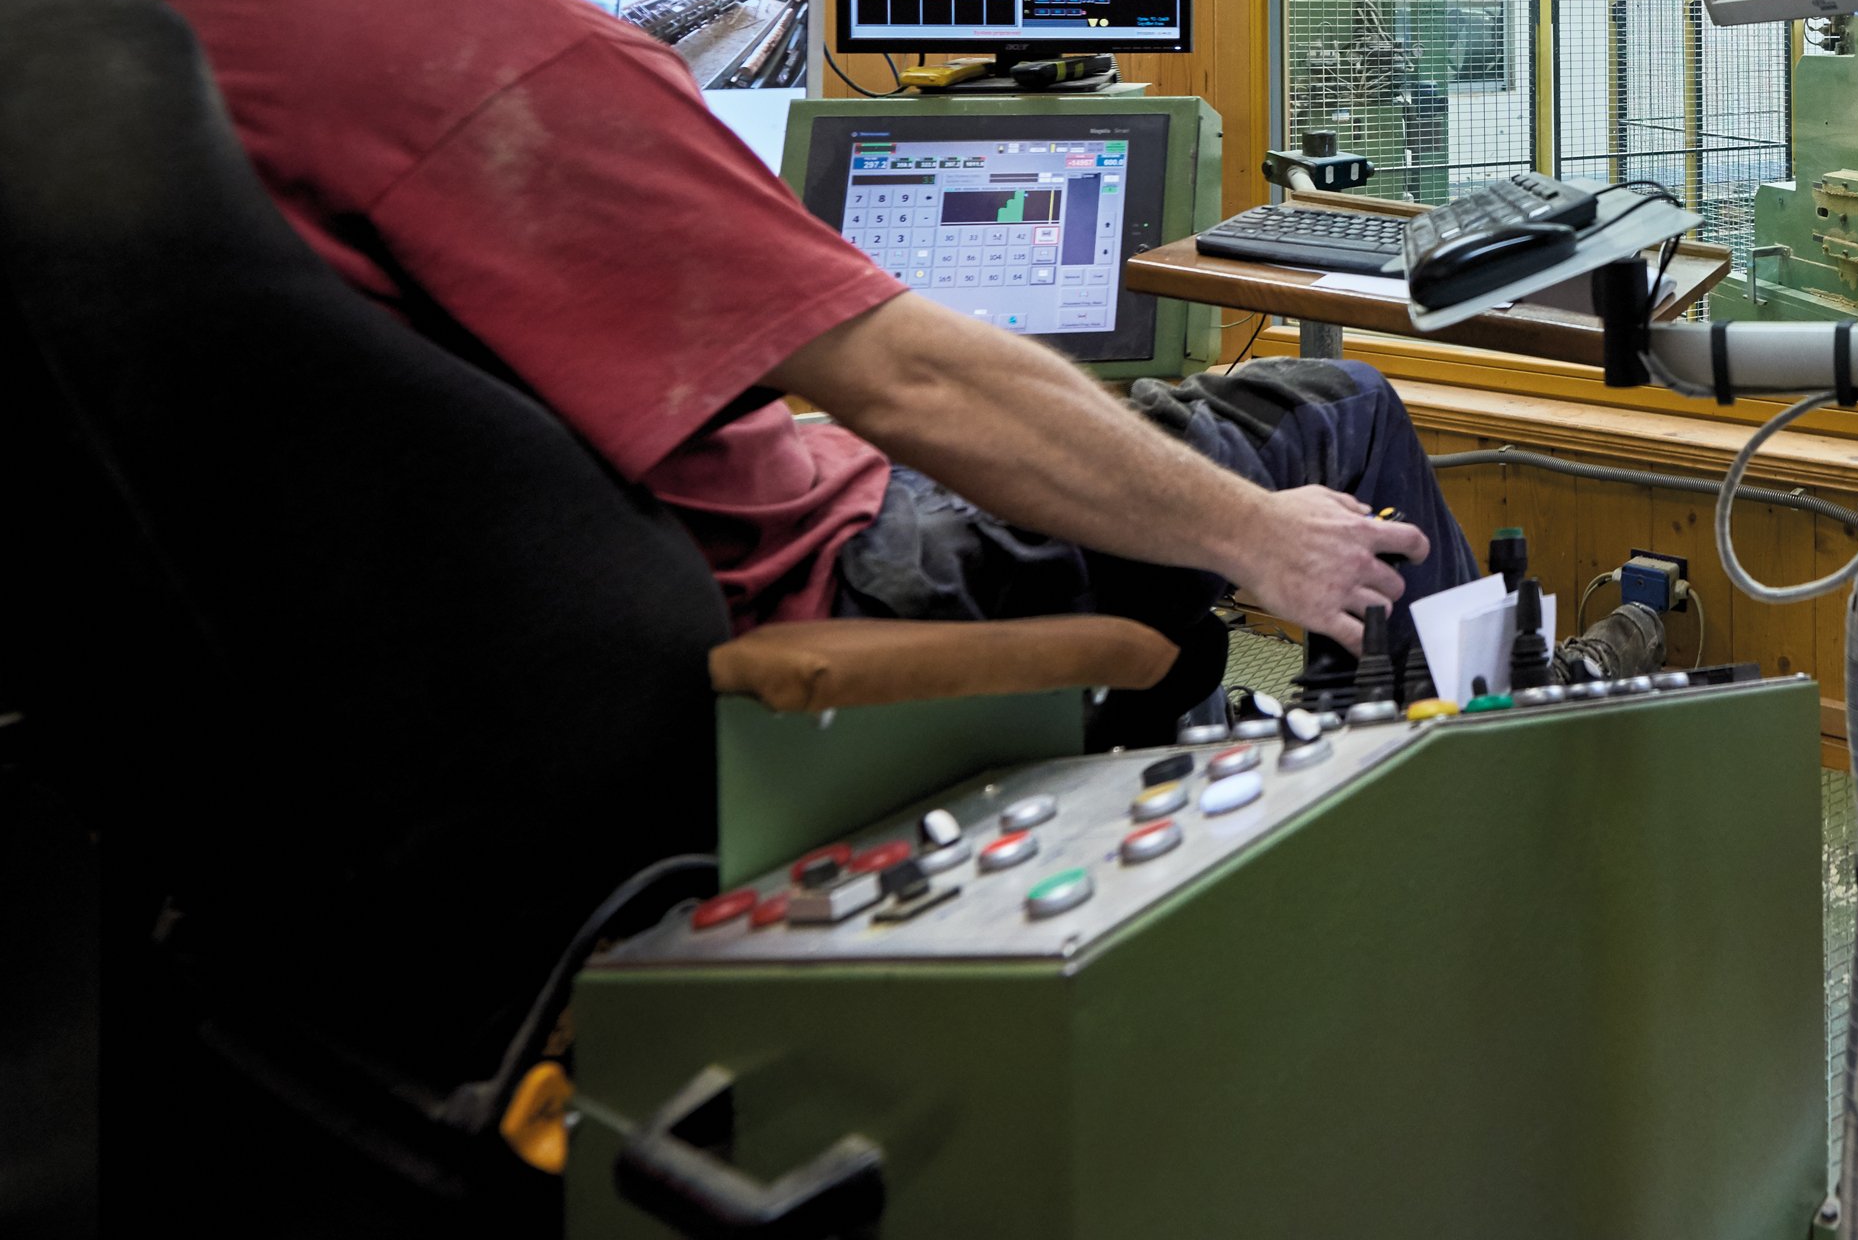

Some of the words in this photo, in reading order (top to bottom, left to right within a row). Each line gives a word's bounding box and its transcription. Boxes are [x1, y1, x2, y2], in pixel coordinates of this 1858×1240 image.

[1005, 43, 1030, 51] acer
[863, 161, 887, 169] 297.2
[922, 175, 935, 184] 33
[855, 195, 863, 203] 7
[878, 194, 886, 203] 8
[901, 194, 909, 202] 9
[852, 215, 860, 223] 4
[876, 215, 884, 223] 5
[899, 214, 907, 223] 6
[850, 236, 857, 244] 1
[873, 235, 881, 244] 2
[897, 234, 905, 243] 3
[945, 234, 954, 242] 30
[969, 233, 978, 241] 33
